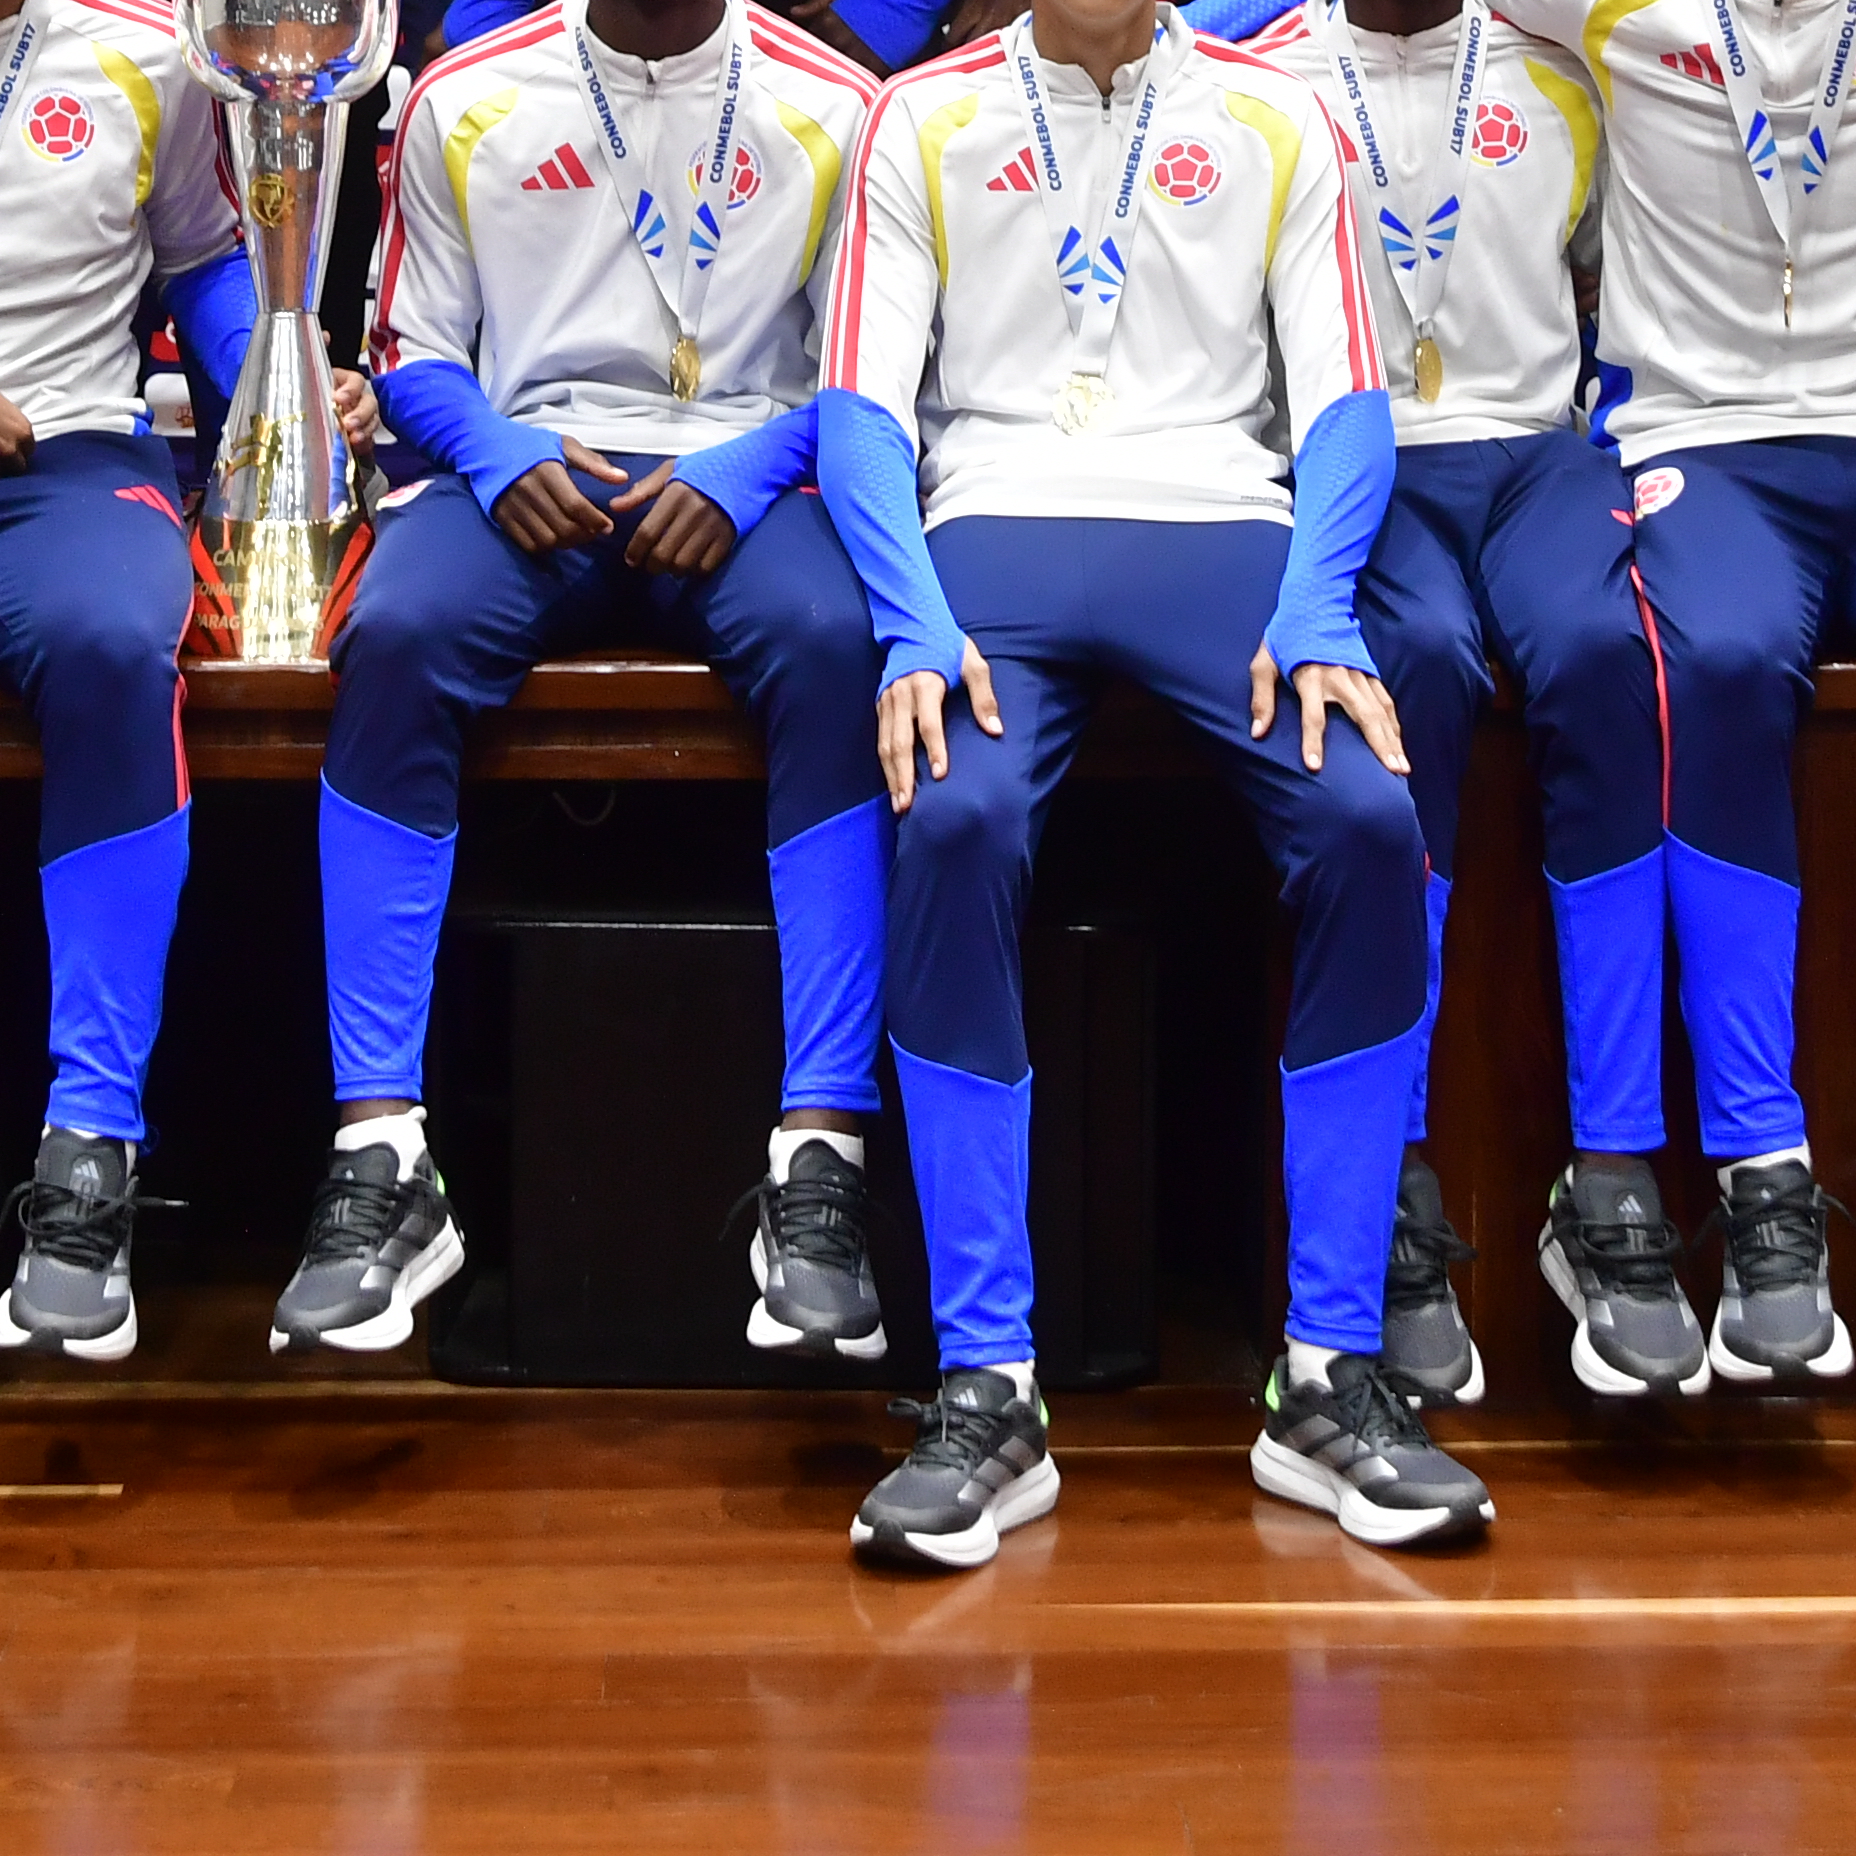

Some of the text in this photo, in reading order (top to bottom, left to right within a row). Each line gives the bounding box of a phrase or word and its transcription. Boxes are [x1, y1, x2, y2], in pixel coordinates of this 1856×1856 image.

[7, 23, 37, 74] SUB17
[588, 75, 628, 160] CONMEBOL
[709, 43, 744, 184] CONMEBOL SUB17
[1448, 16, 1482, 157] CONMEBOL SUB17
[1018, 54, 1063, 192] CONMEBOL SUB17
[1115, 81, 1159, 219] CONMEBOL SUB17
[1337, 54, 1389, 188] CONMEBOL SUB17
